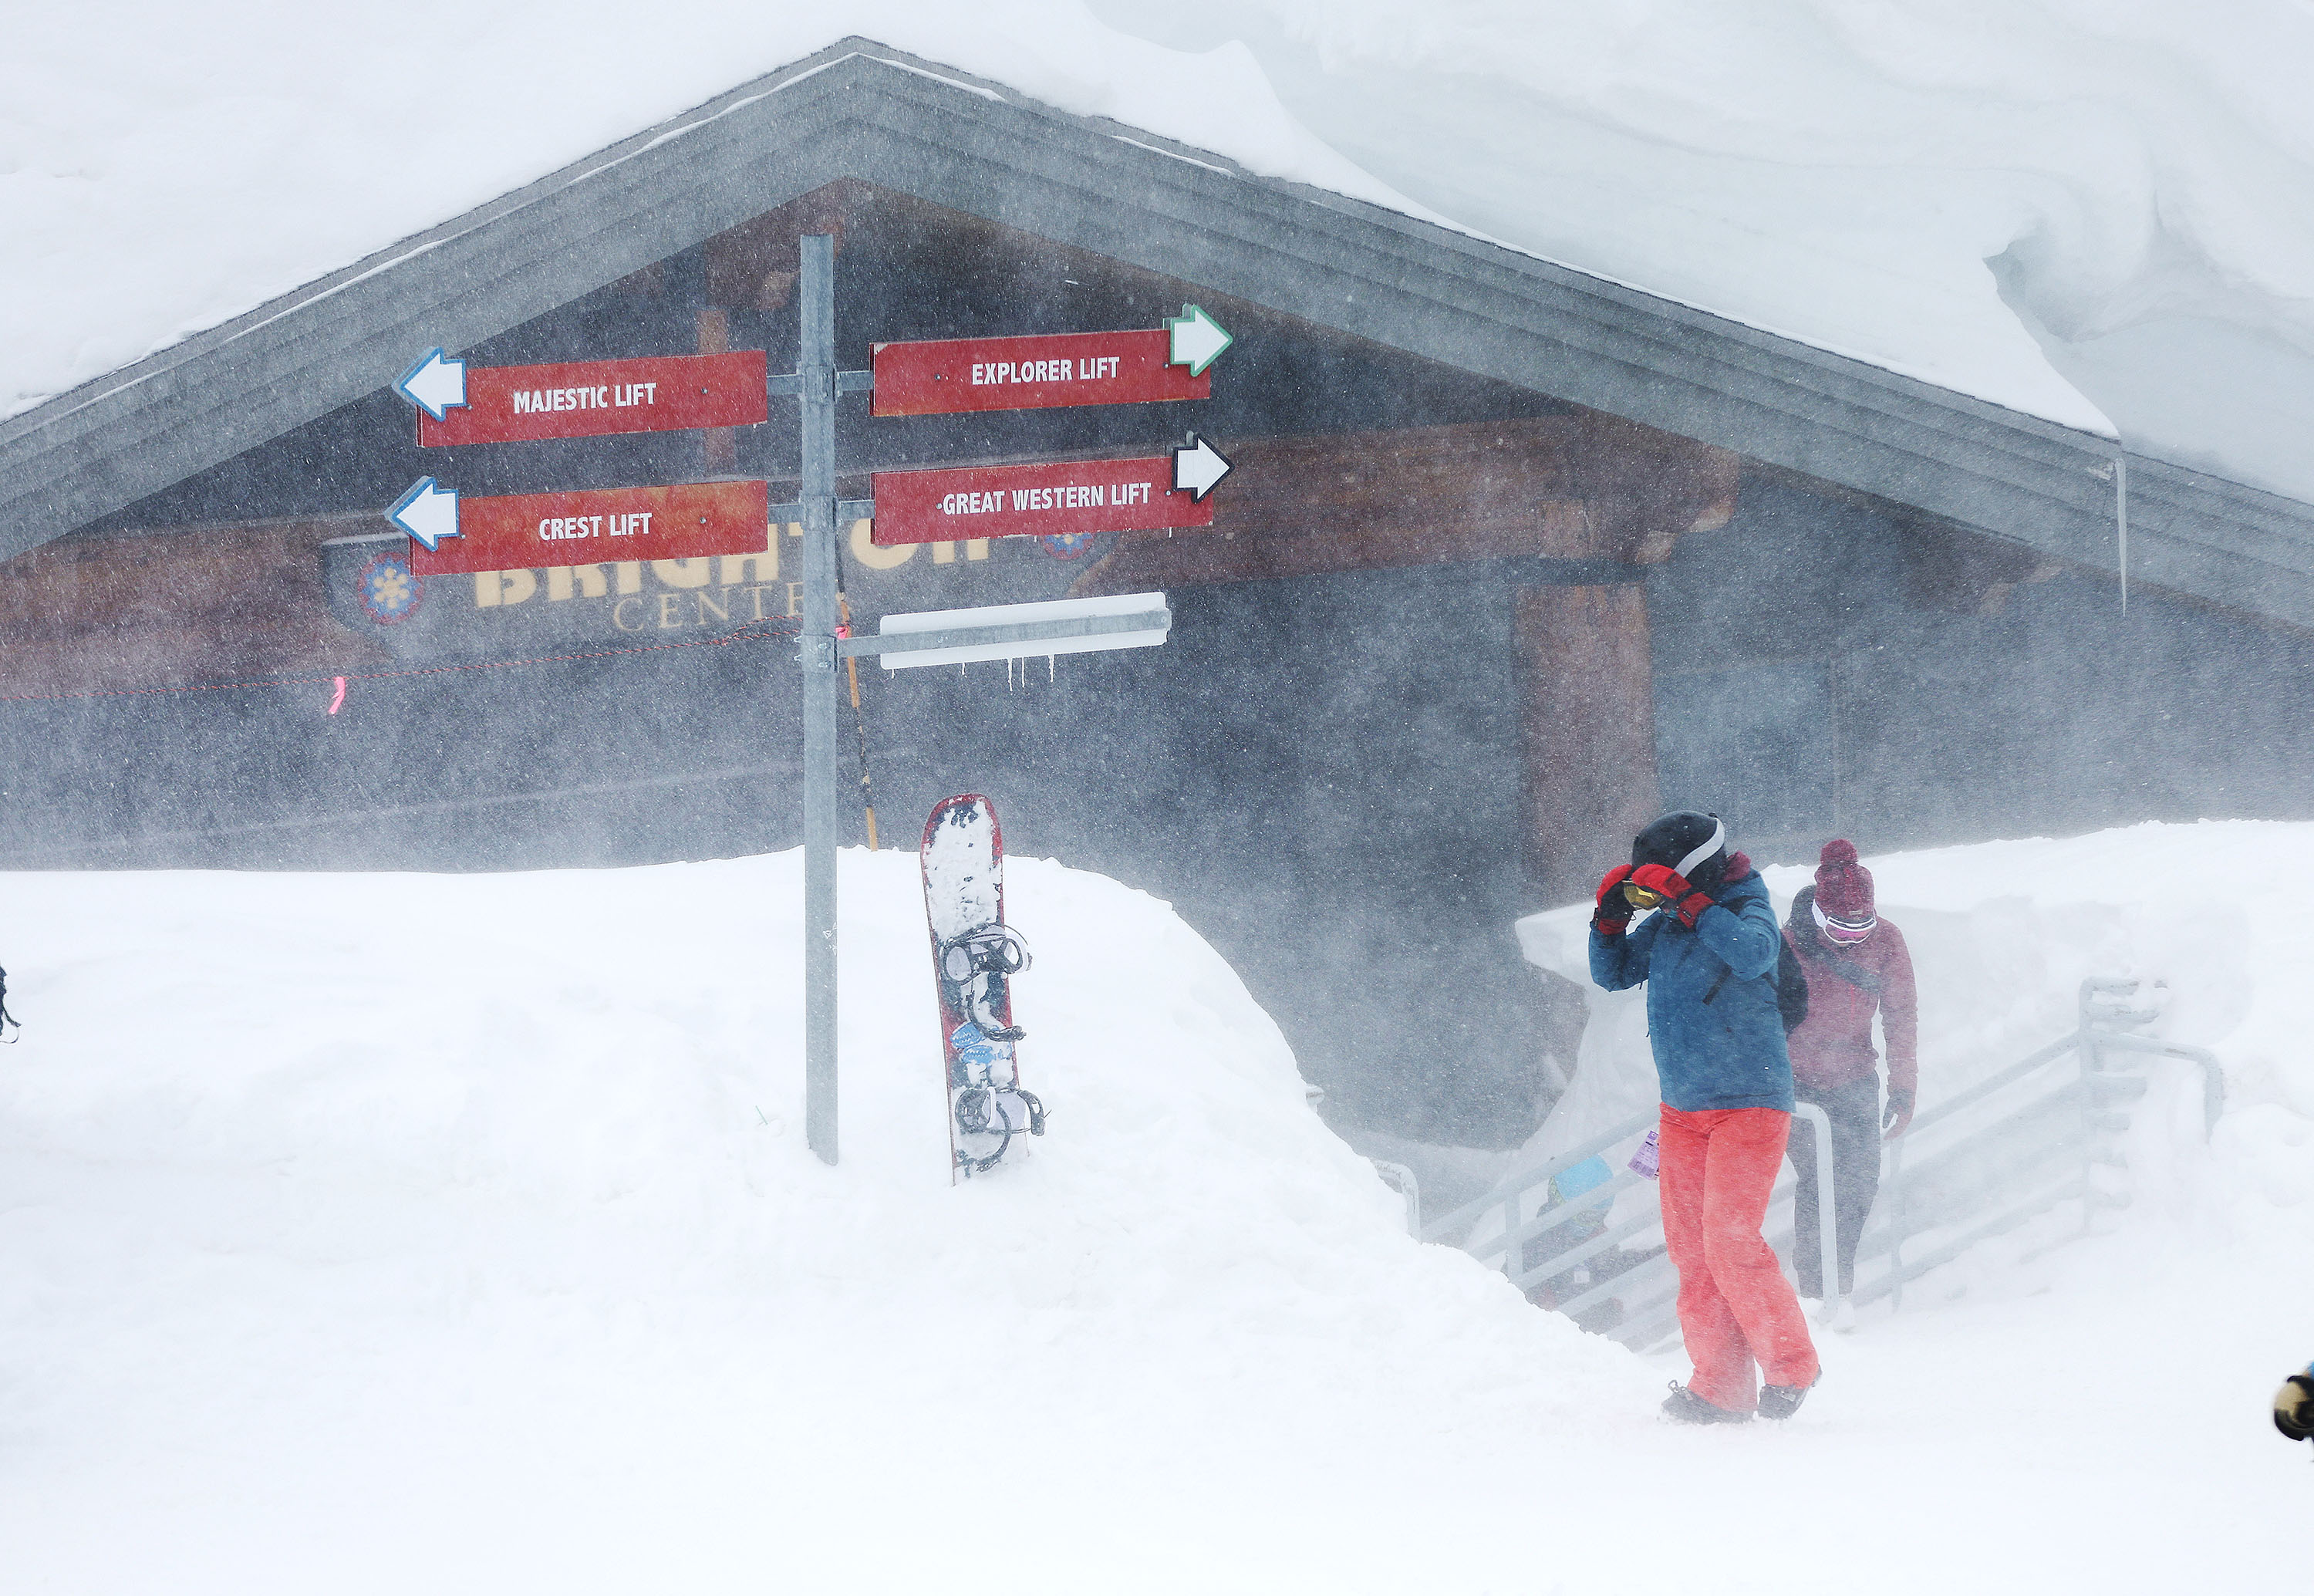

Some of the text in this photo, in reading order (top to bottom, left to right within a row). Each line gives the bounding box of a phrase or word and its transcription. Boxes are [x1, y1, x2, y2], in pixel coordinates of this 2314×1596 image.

[972, 356, 1120, 385] EXPLORER LIFT
[513, 383, 656, 413] MAJESTIC LIFT
[943, 482, 1152, 515] GREAT WESTERN LIFT
[539, 513, 653, 540] CREST LIFT
[614, 581, 805, 631] CENTE
